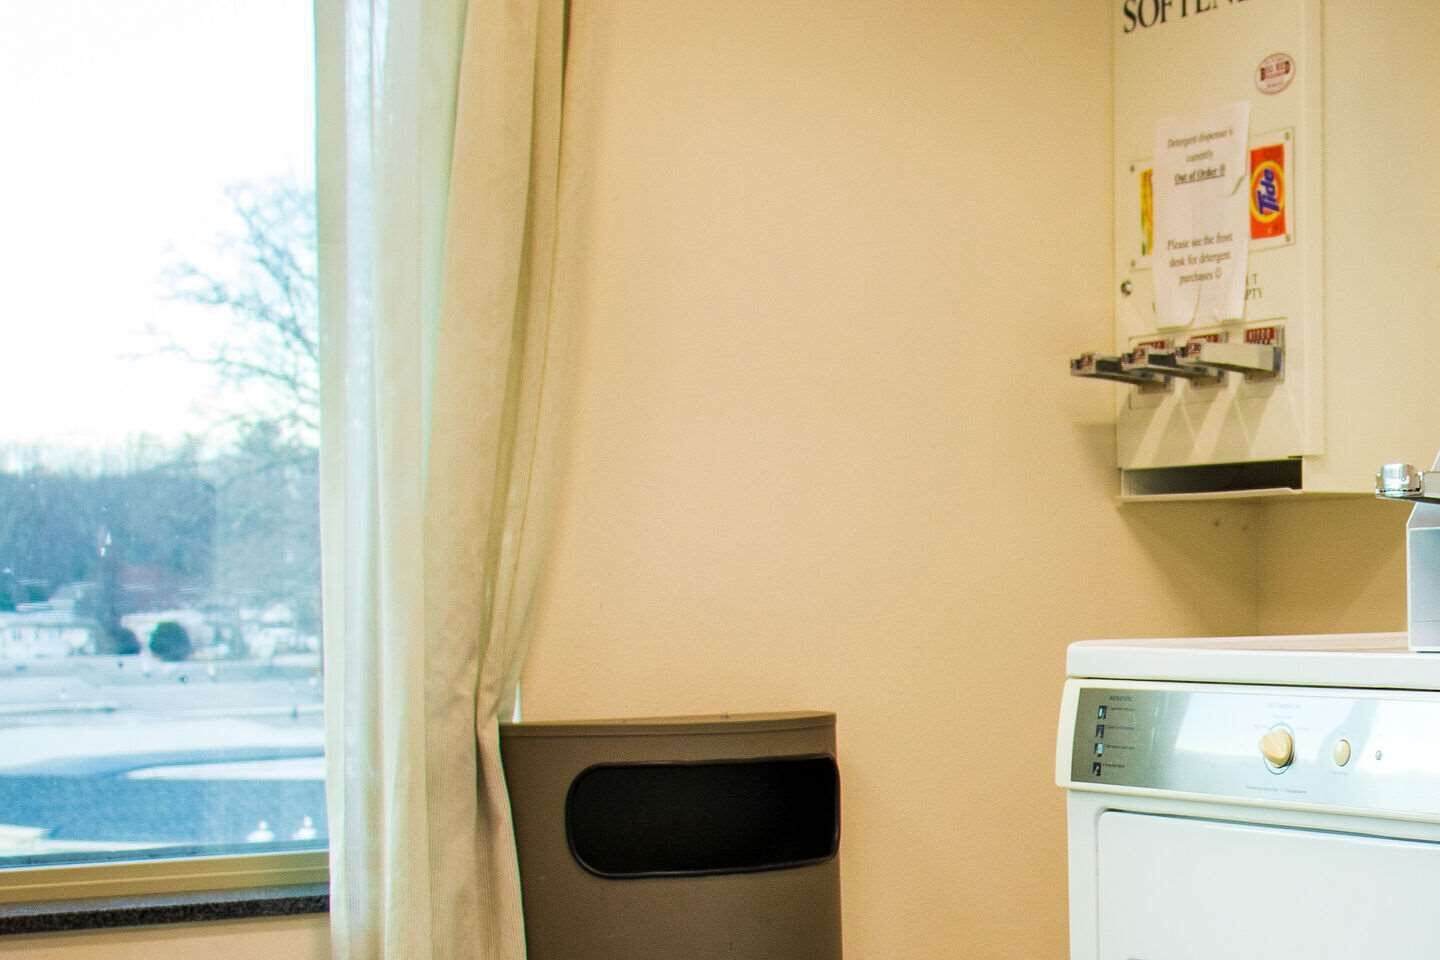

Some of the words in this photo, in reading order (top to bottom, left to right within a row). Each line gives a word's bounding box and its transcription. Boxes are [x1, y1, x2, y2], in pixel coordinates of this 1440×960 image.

[1174, 172, 1187, 184] Out
[1197, 166, 1217, 178] Order
[1256, 168, 1281, 214] Tide
[1167, 239, 1189, 251] Please
[1203, 234, 1215, 246] the
[1169, 255, 1185, 267] desk
[1188, 254, 1197, 265] for
[1199, 251, 1231, 264] detergent
